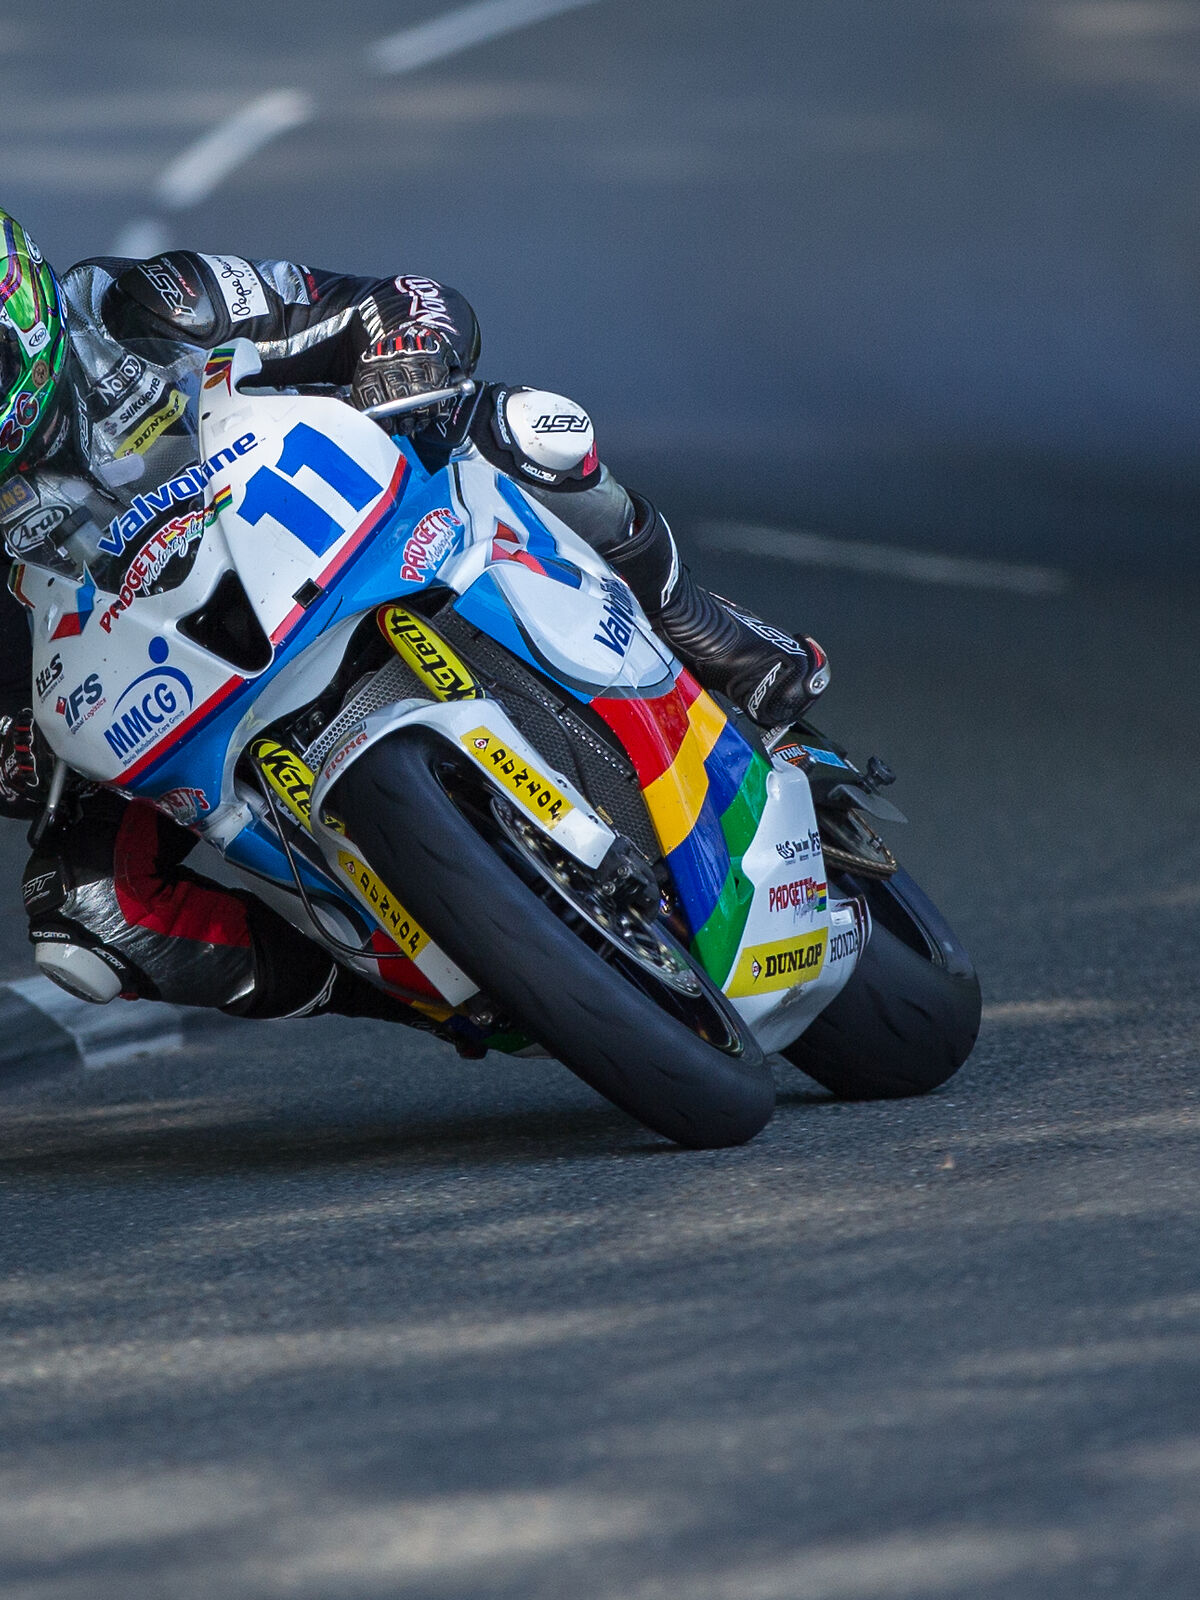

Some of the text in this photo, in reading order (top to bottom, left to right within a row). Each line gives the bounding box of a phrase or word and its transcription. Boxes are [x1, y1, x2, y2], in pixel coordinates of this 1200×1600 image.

[137, 262, 197, 318] RST
[531, 414, 590, 434] RST
[12, 508, 63, 544] Arai
[97, 431, 258, 558] Valvoline
[236, 420, 385, 559] 11
[400, 507, 462, 583] PADGETT'S
[65, 672, 103, 729] IFS
[103, 682, 177, 760] MMCG
[490, 748, 564, 822] DUNLOP
[359, 874, 423, 954] DUNLOP
[765, 942, 823, 979] DUNLOP
